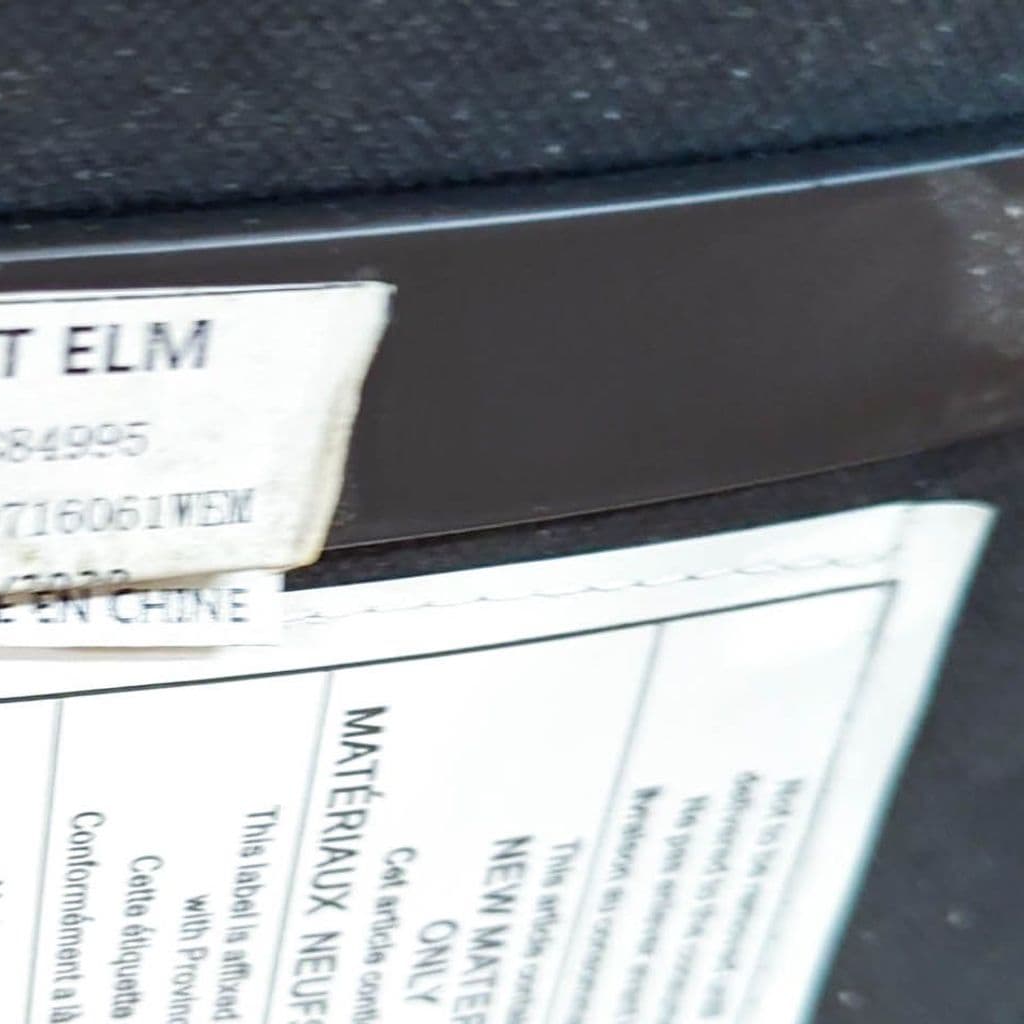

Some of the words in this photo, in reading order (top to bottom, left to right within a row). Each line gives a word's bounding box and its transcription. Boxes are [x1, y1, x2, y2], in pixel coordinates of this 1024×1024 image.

[61, 318, 212, 376] ELM
[107, 587, 252, 623] CHINE
[238, 805, 281, 857] This
[302, 705, 390, 916] MATÉRIAUX
[123, 854, 165, 917] Cette
[227, 863, 271, 919] label
[378, 847, 417, 889] Cet
[475, 835, 535, 914] NEW
[540, 837, 582, 887] This
[55, 810, 106, 982] Conformément
[176, 894, 213, 942] with
[225, 924, 255, 944] is
[362, 896, 400, 965] article
[108, 923, 156, 1019] étiquette
[212, 950, 252, 1022] affixed
[404, 920, 459, 1004] ONLY
